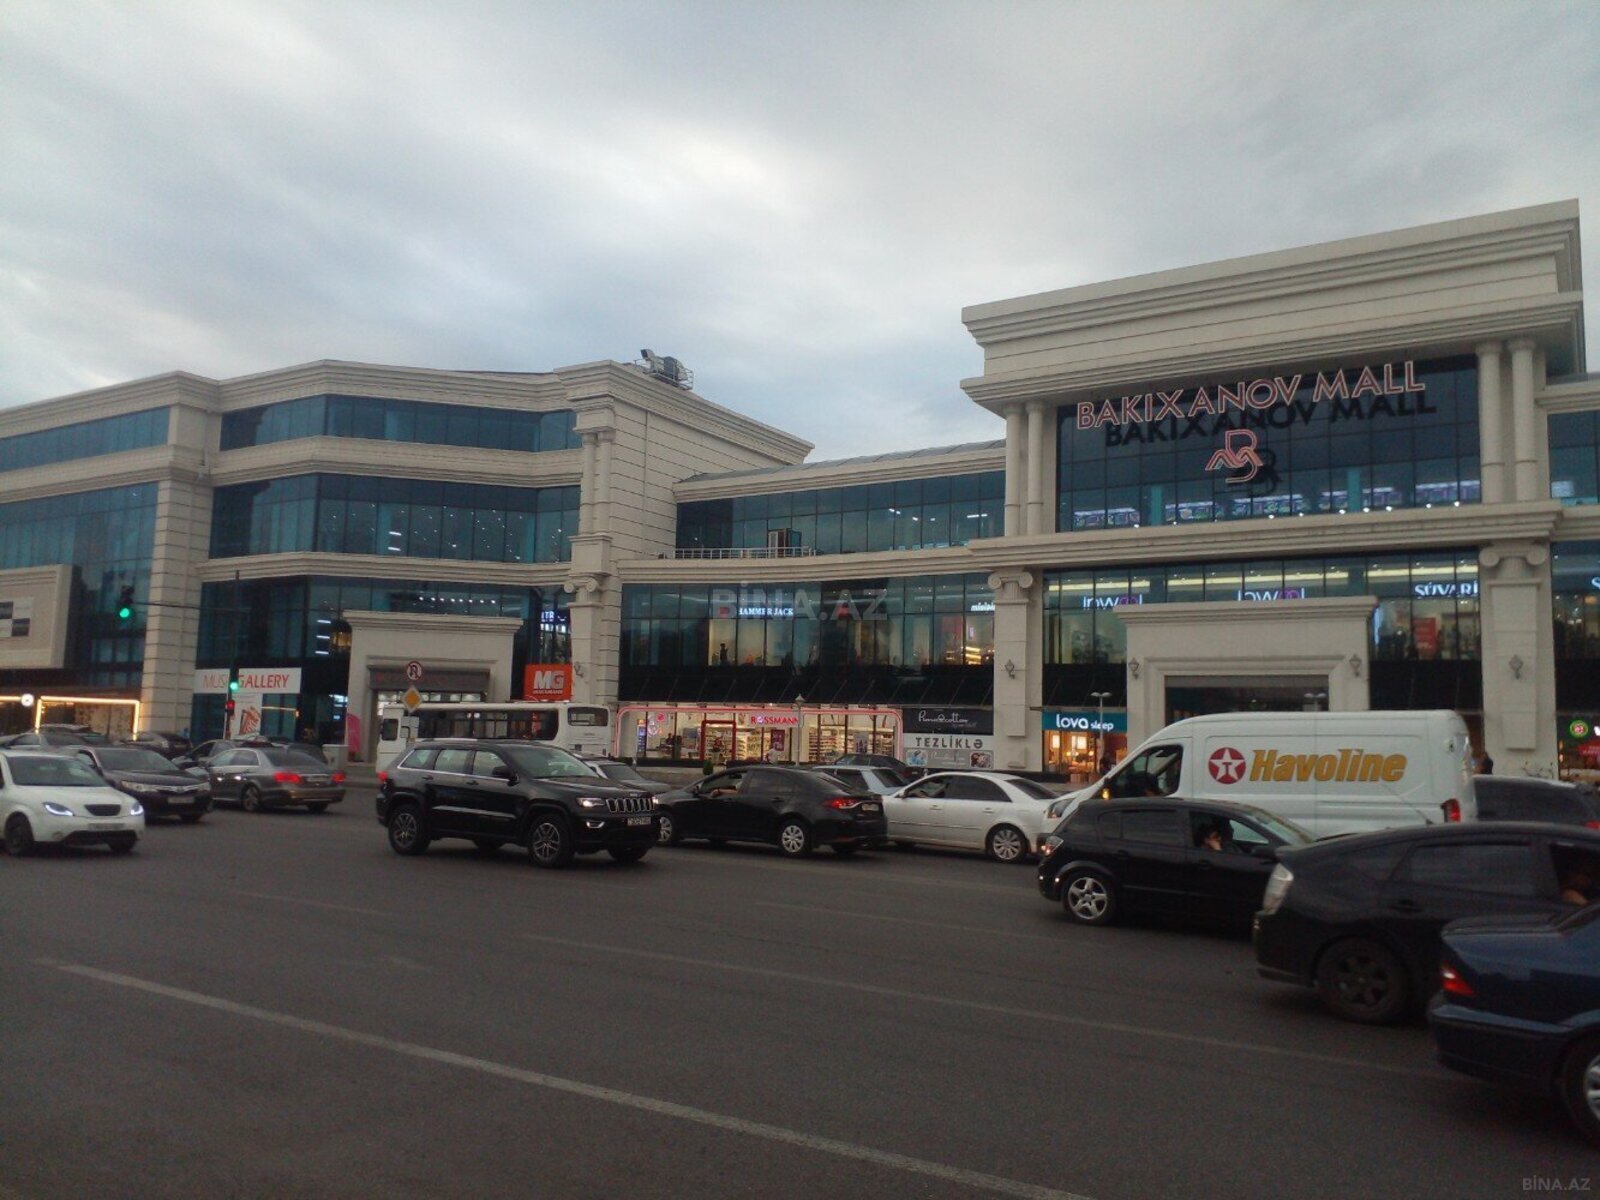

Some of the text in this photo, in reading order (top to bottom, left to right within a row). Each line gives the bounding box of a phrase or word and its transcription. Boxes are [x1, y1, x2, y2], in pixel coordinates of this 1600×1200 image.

[1076, 360, 1426, 430] BAKIXANOV MALL
[774, 607, 794, 616] JACK
[533, 670, 565, 690] MG
[1055, 713, 1089, 730] lova
[914, 735, 984, 749] TEZLİKLƏ
[1249, 747, 1408, 783] Havoline
